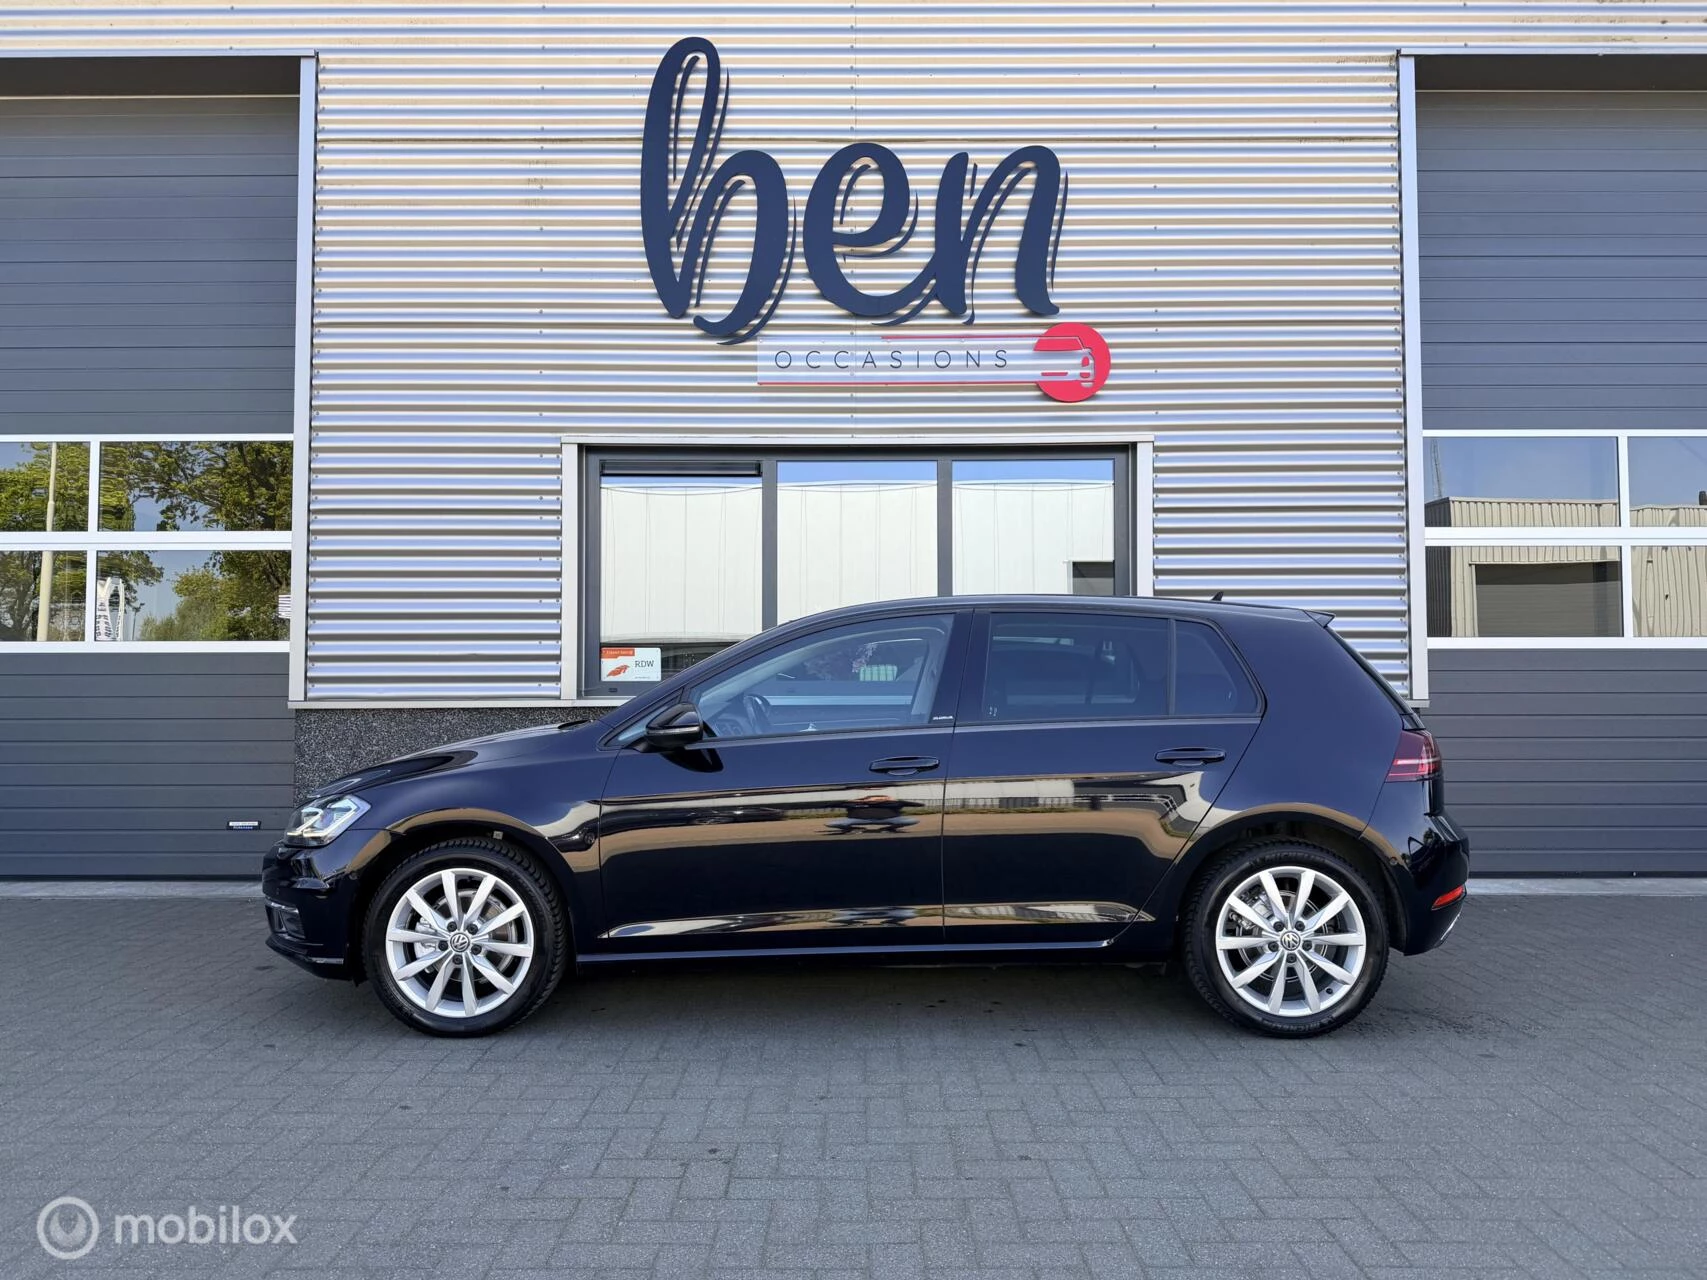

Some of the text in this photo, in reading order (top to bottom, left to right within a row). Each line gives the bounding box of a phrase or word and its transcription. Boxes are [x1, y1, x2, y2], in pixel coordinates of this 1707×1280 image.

[640, 37, 1069, 344] ben
[774, 349, 1008, 369] OCCASIONS
[634, 660, 654, 668] RDW
